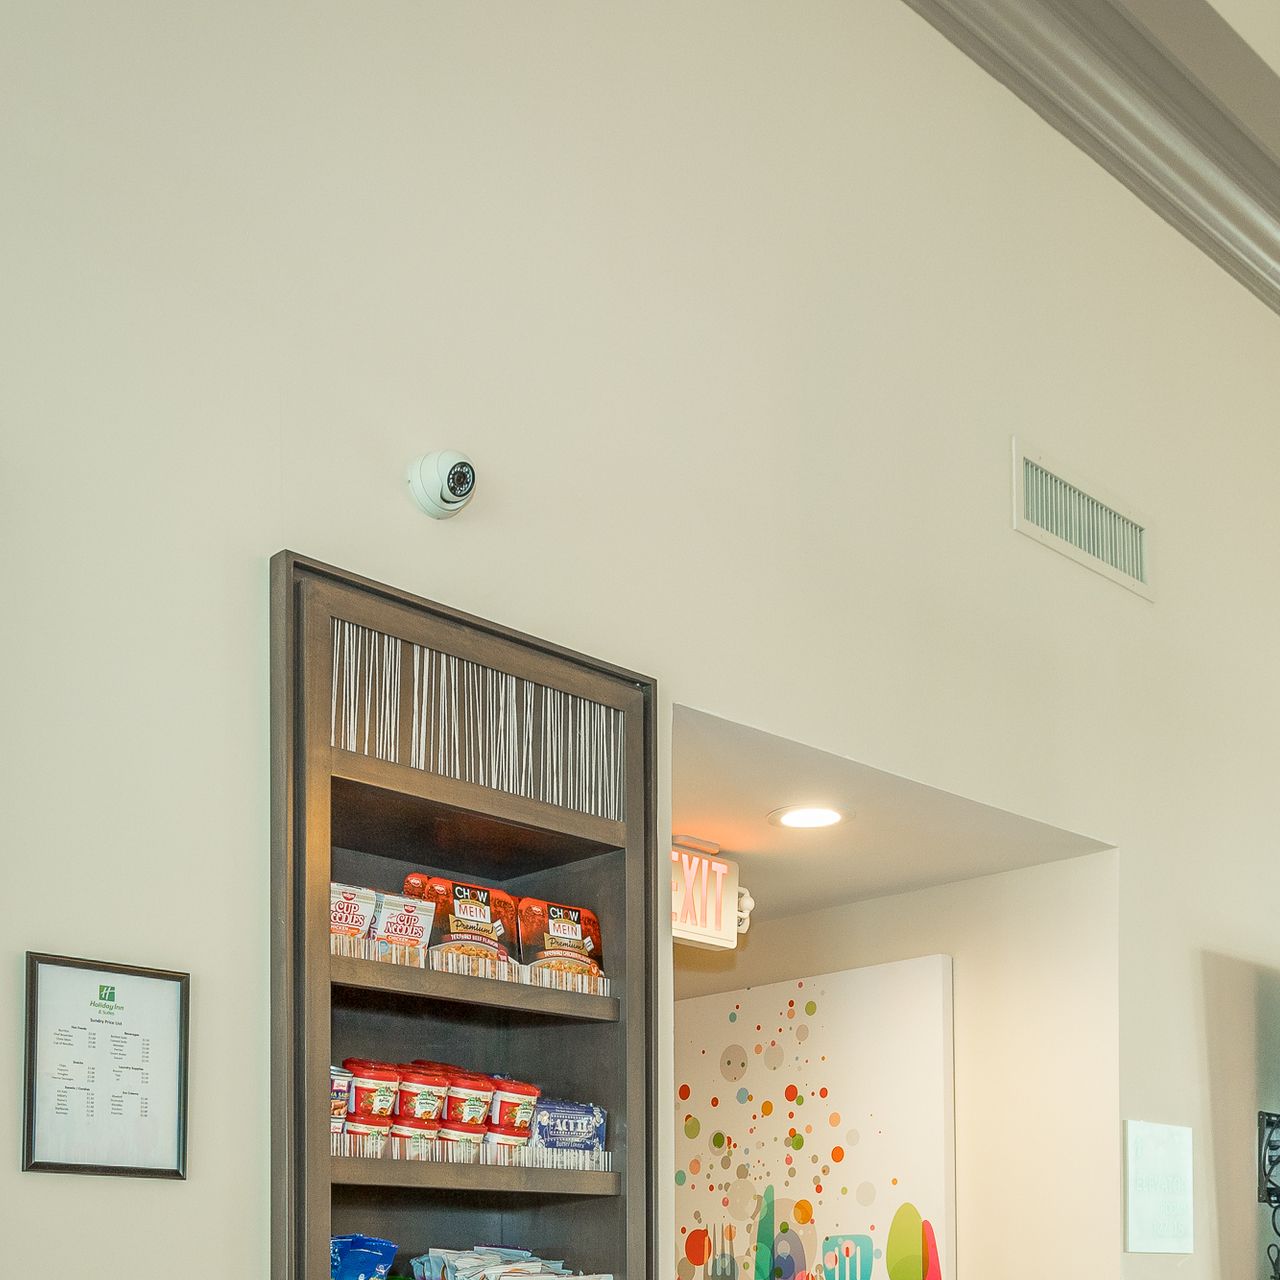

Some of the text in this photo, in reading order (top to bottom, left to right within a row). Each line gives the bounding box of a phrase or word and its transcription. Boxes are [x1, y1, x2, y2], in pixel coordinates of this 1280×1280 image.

[455, 887, 488, 903] CHOW
[336, 901, 360, 914] CUP
[459, 904, 486, 919] MEIN
[550, 907, 579, 922] CHOW
[331, 911, 364, 928] OODLES
[396, 914, 419, 926] CUP
[384, 921, 424, 938] NOODLES
[452, 920, 494, 935] Premium
[553, 923, 578, 937] MEIN
[547, 937, 585, 951] Premium
[90, 1001, 114, 1011] Holiday
